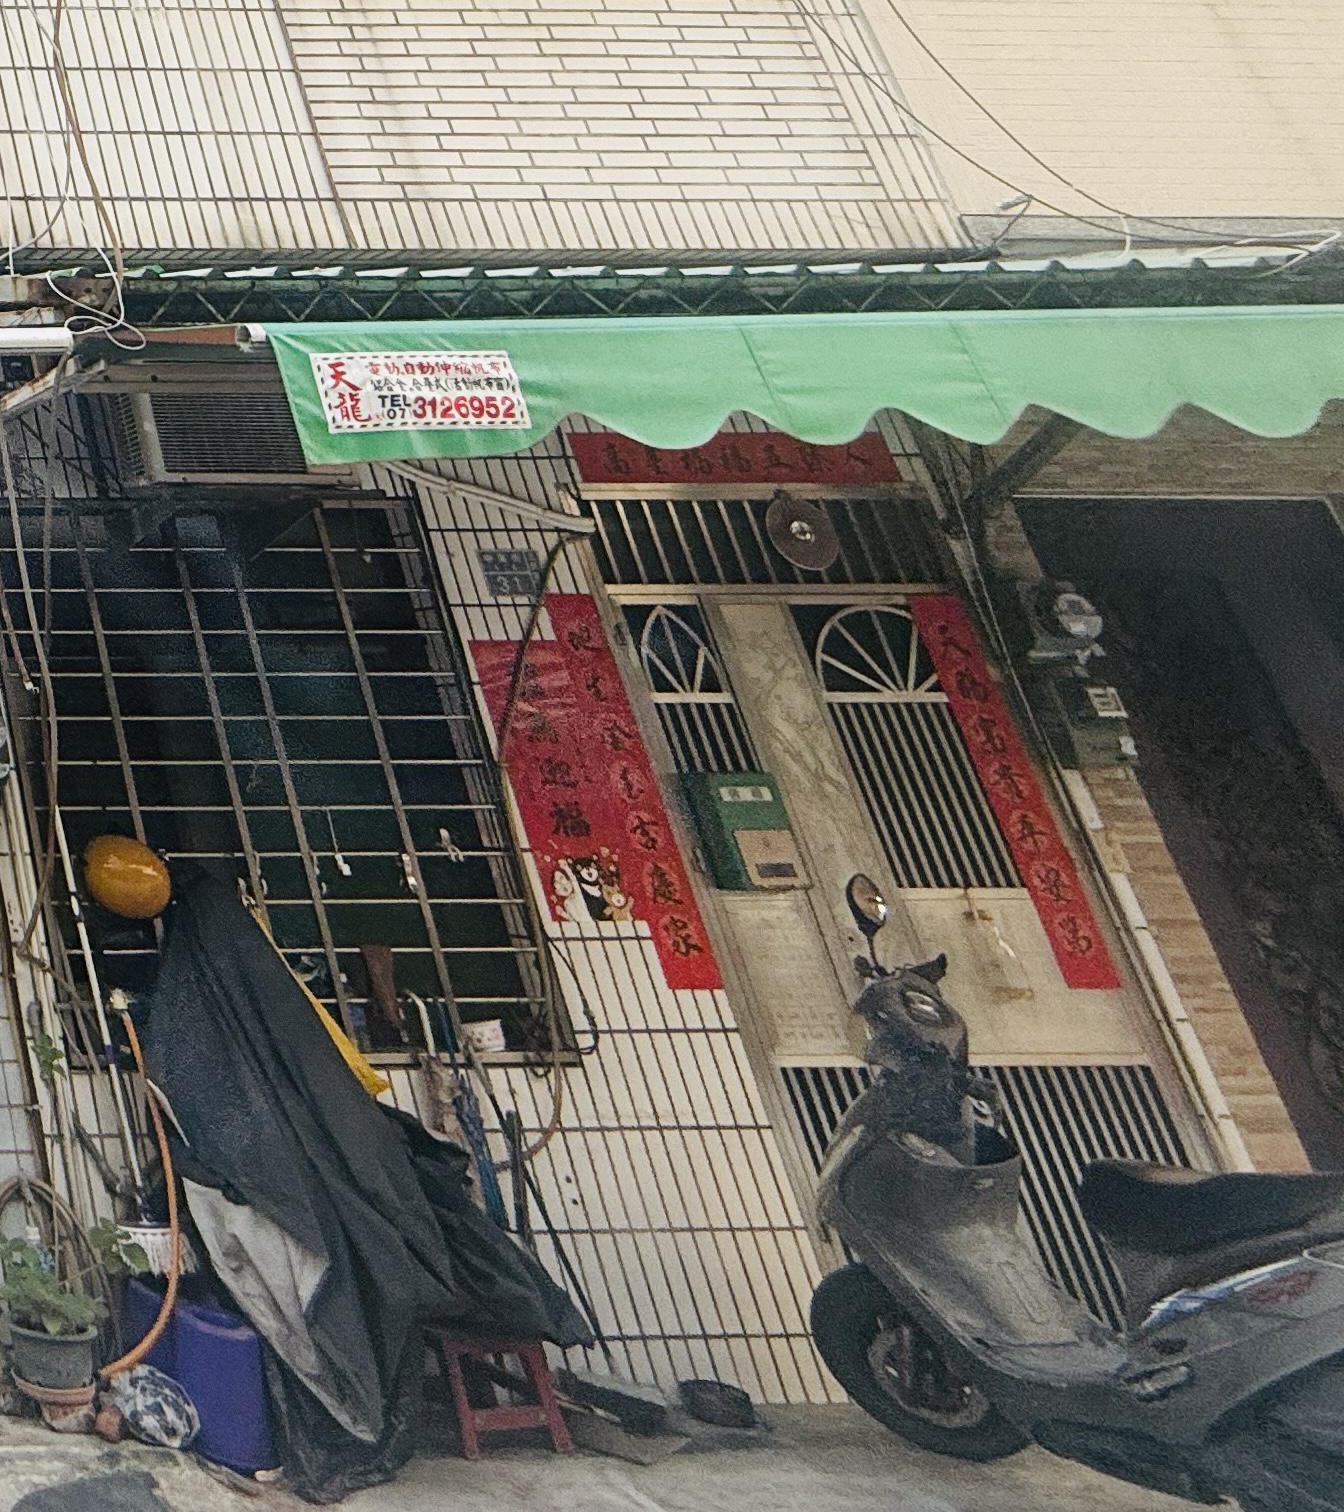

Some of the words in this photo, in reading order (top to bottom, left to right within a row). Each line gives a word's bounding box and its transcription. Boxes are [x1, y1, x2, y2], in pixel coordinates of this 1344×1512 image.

[327, 361, 373, 422] 天龍
[377, 393, 412, 408] TEL
[413, 395, 516, 419] 3126952
[496, 575, 524, 593] 31
